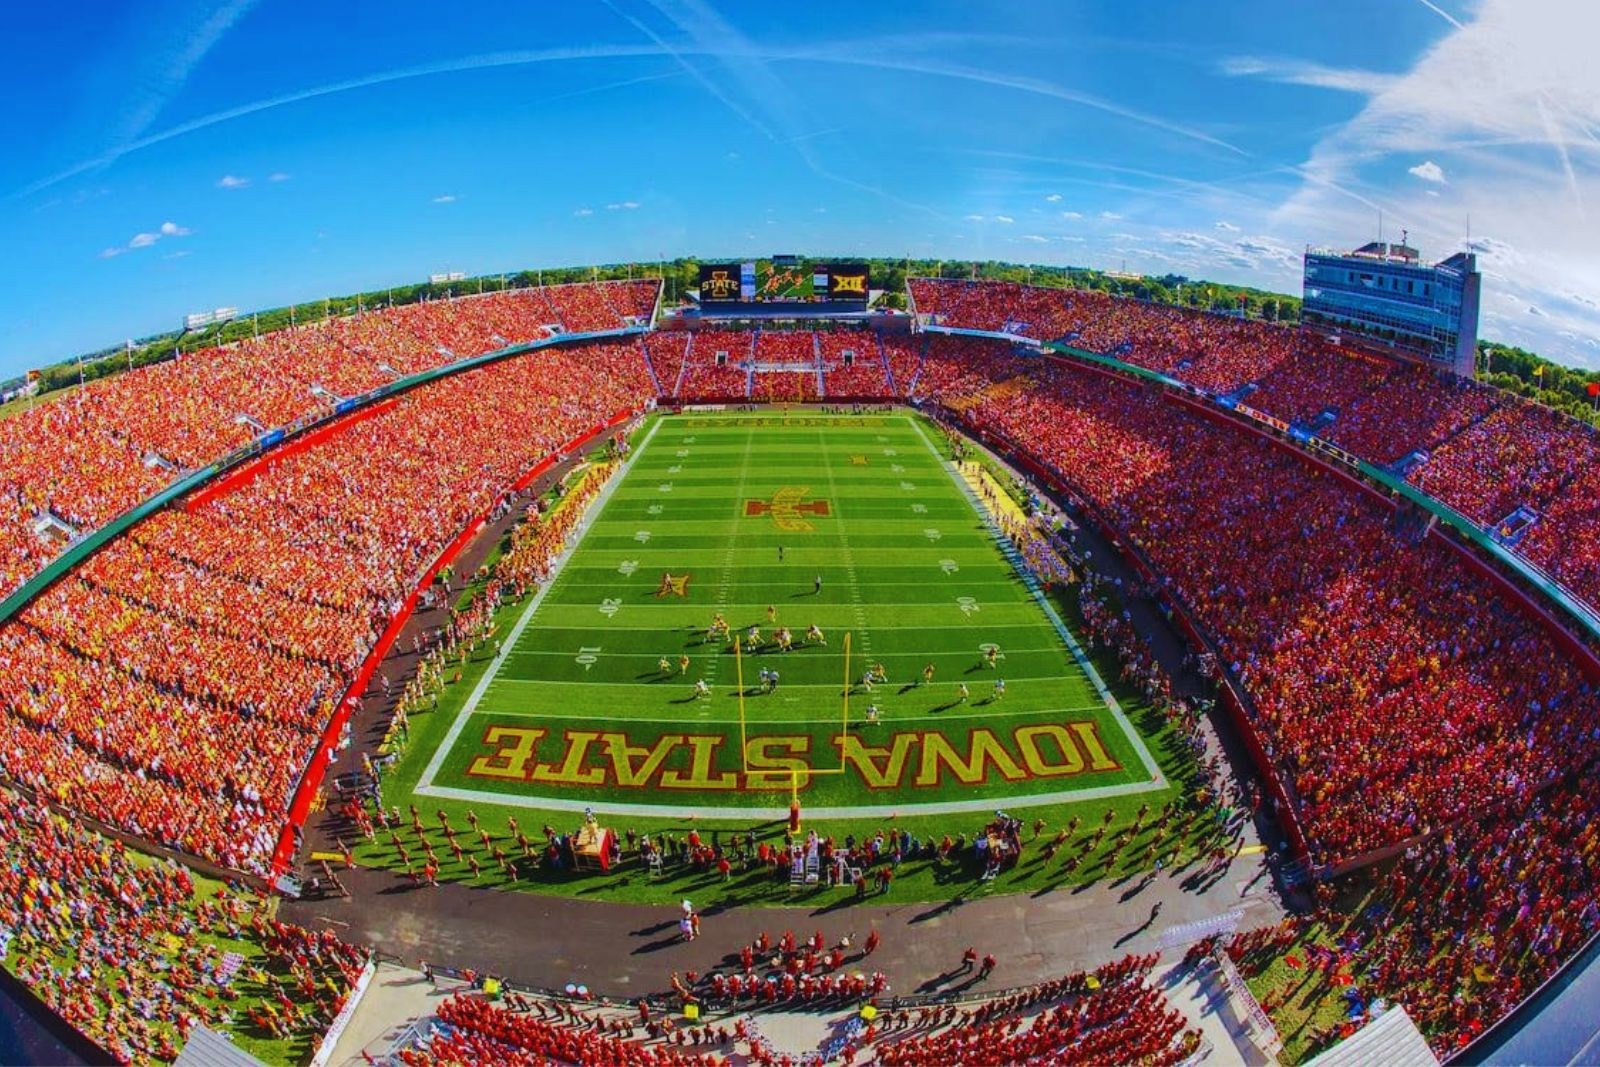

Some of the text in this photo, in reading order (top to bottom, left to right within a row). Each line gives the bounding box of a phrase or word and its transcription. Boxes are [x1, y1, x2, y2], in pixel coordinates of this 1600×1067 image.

[701, 279, 739, 291] STATE
[575, 646, 601, 664] 10
[464, 719, 1124, 792] IOWA STATE
